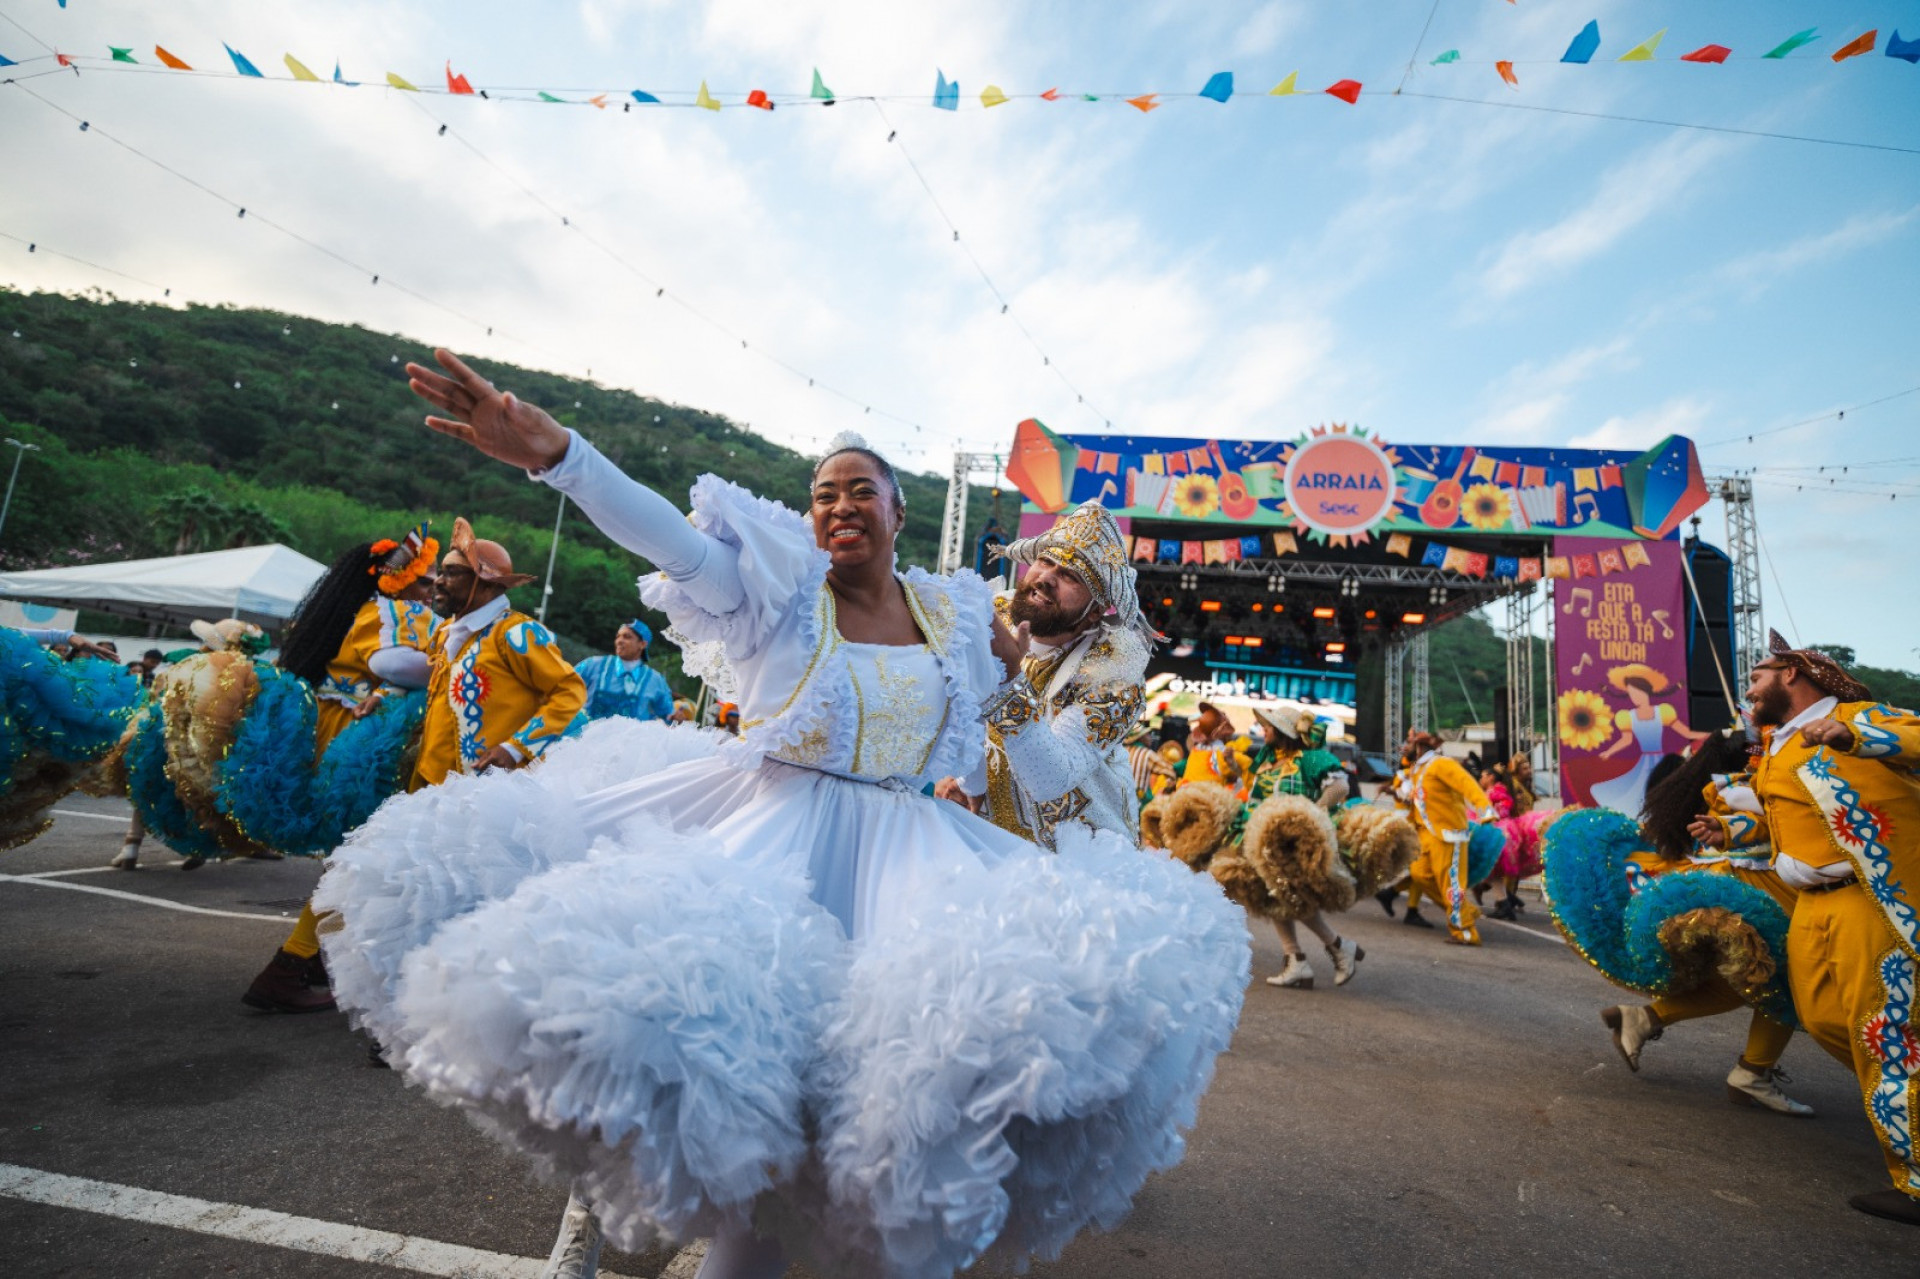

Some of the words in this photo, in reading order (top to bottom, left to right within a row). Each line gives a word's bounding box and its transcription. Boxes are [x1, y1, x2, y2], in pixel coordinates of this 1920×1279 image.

[1319, 502, 1359, 516] Sesc
[1604, 582, 1634, 601] EITA
[1598, 601, 1626, 621] QUE
[1631, 603, 1642, 621] A
[1586, 619, 1630, 640] FESTA
[1635, 619, 1654, 643] TÁ
[1600, 640, 1646, 663] LINDA!
